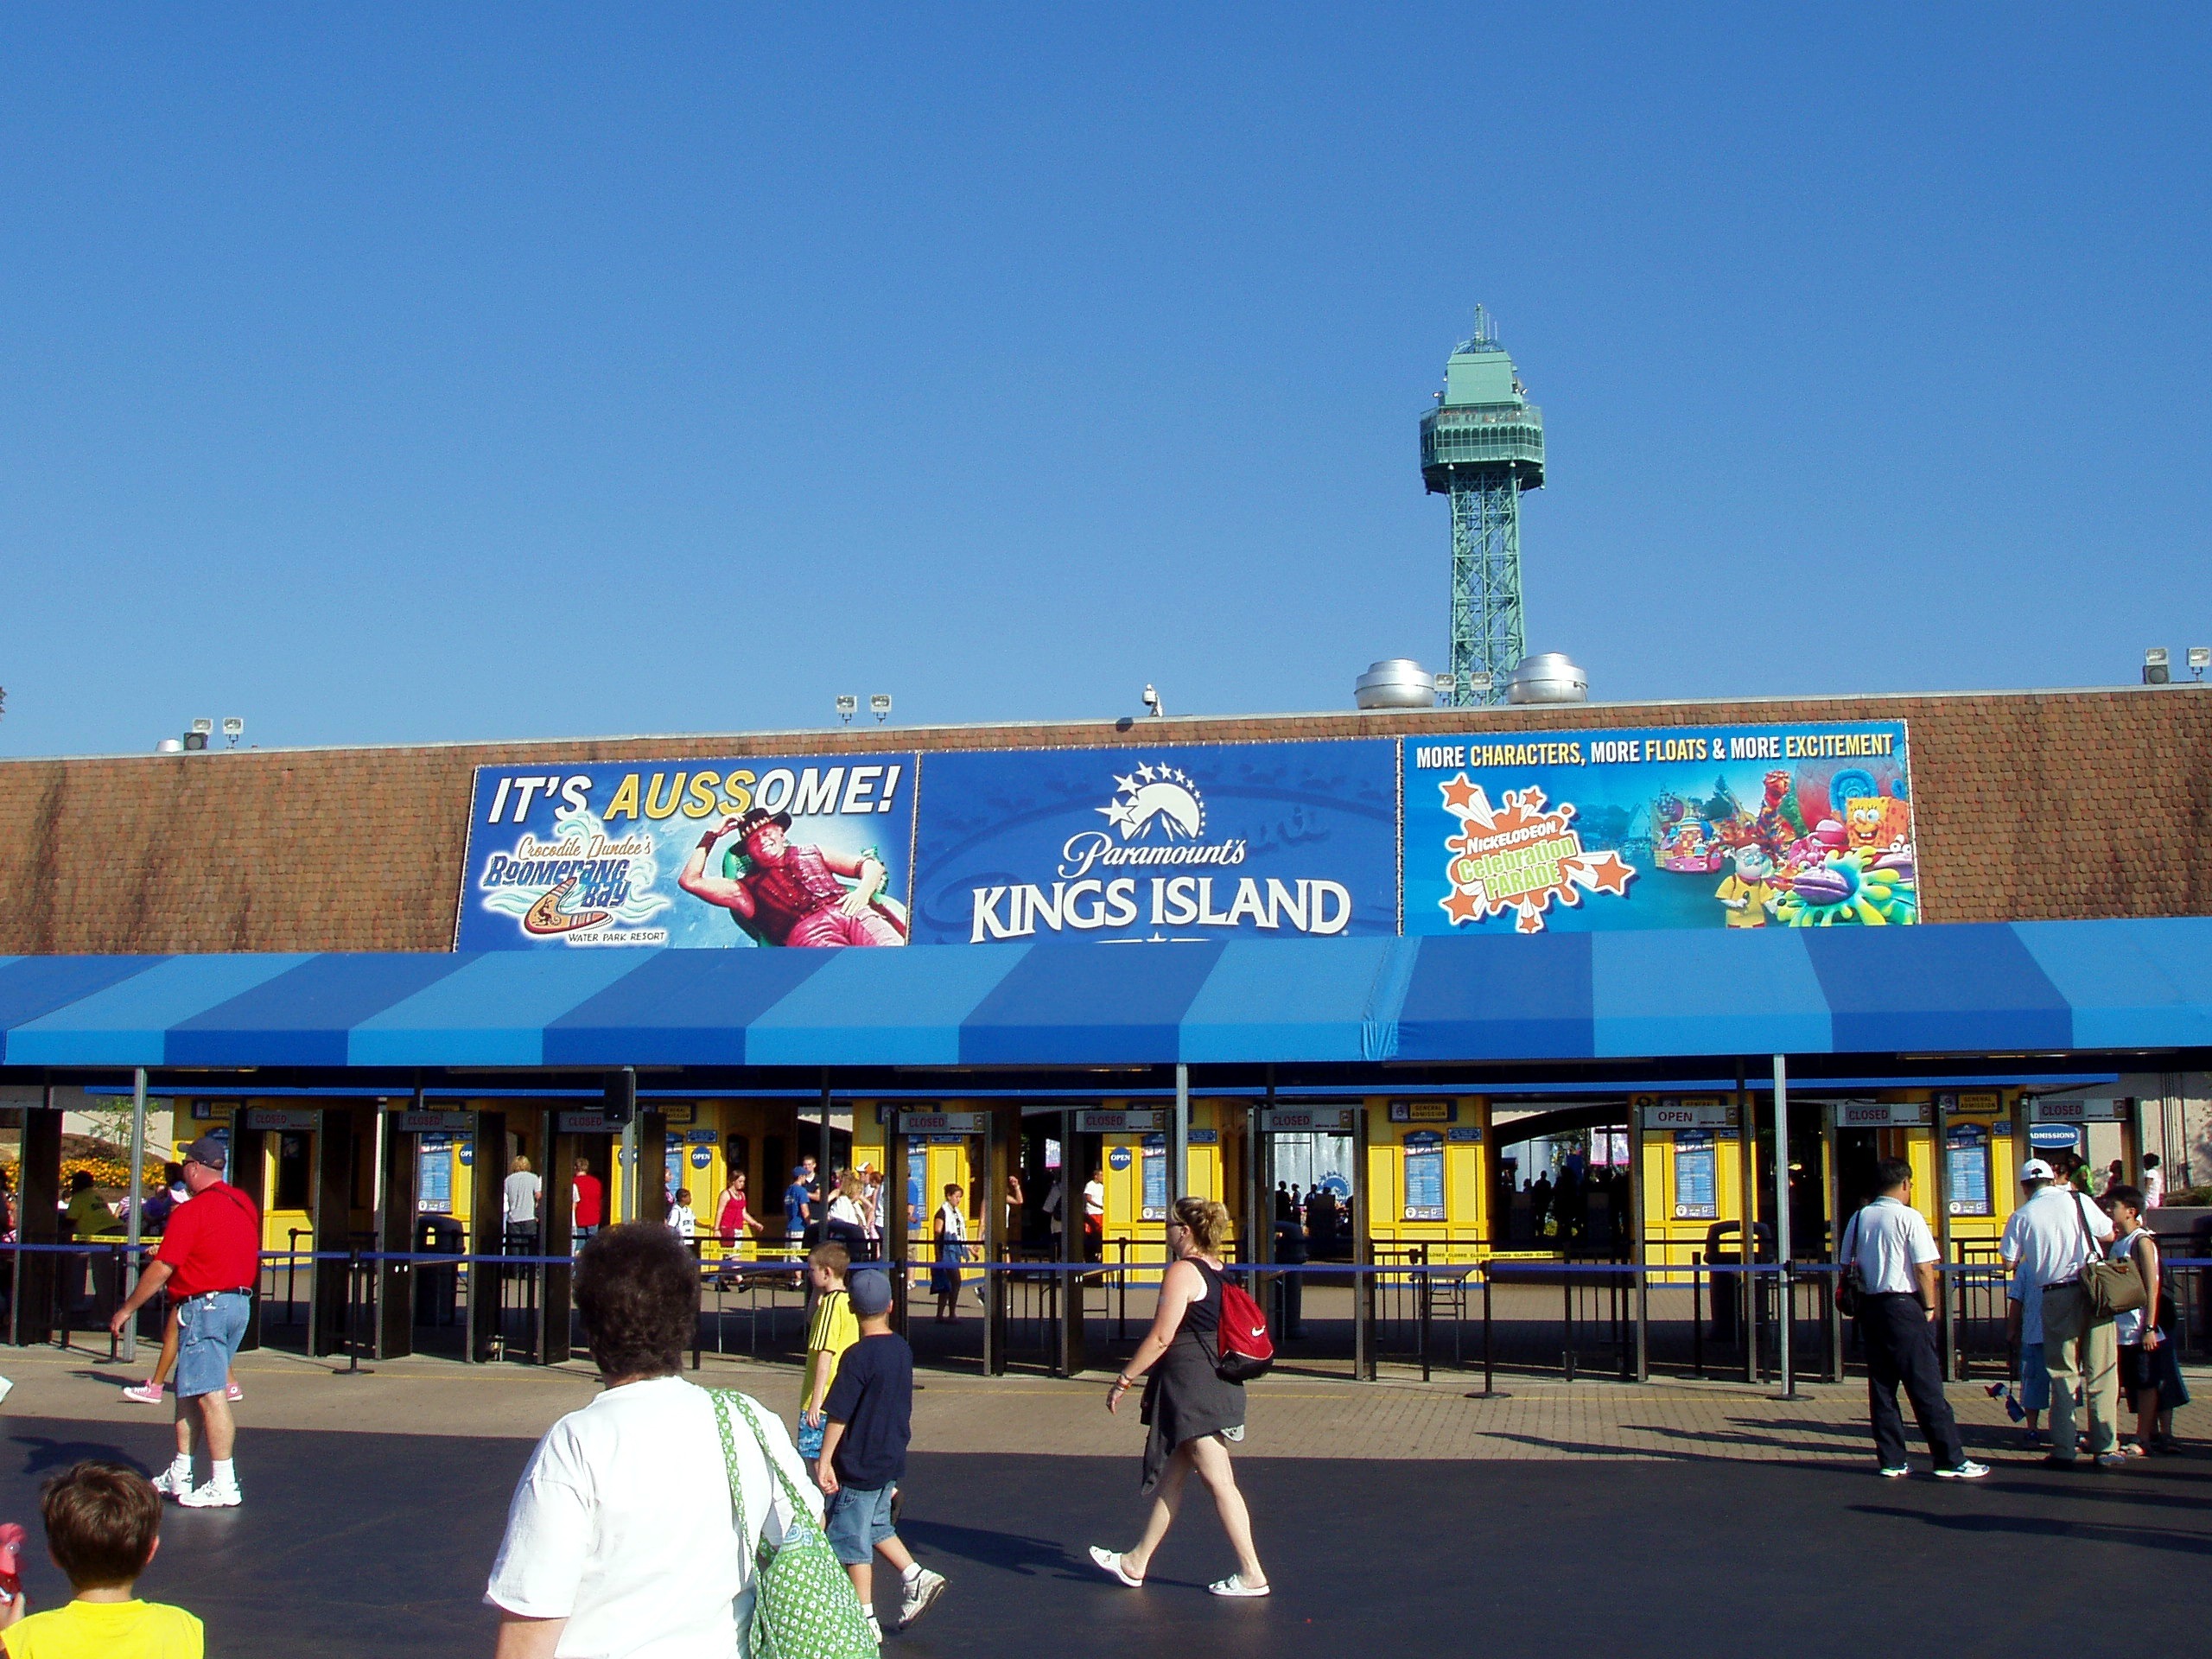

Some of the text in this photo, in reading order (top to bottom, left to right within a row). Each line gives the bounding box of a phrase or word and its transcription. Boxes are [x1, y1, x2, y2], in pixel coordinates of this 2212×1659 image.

[1416, 733, 1894, 768] MORE CHARACTERS, MORE FLOATS & MORE EXCITEMENT
[488, 765, 901, 823] IT'S AUSSOME!
[518, 834, 652, 861] Crocodile Dundee's
[1057, 830, 1247, 880] Paramount's
[1459, 836, 1576, 882] Celebration
[1484, 861, 1561, 899] PARADE
[969, 877, 1351, 944] KINGS ISLAND
[568, 931, 665, 942] WATER PARK RESORT
[1658, 1111, 1693, 1122] OPEN
[1848, 1109, 1888, 1121] CLOSED
[2042, 1105, 2082, 1116] CLOSED
[256, 1115, 288, 1124] CLOSED
[408, 1116, 441, 1127] CLOSED
[569, 1117, 602, 1127] CLOSED
[909, 1116, 944, 1128] CLOSED
[1086, 1116, 1123, 1127] CLOSED
[1273, 1116, 1310, 1127] CLOSED
